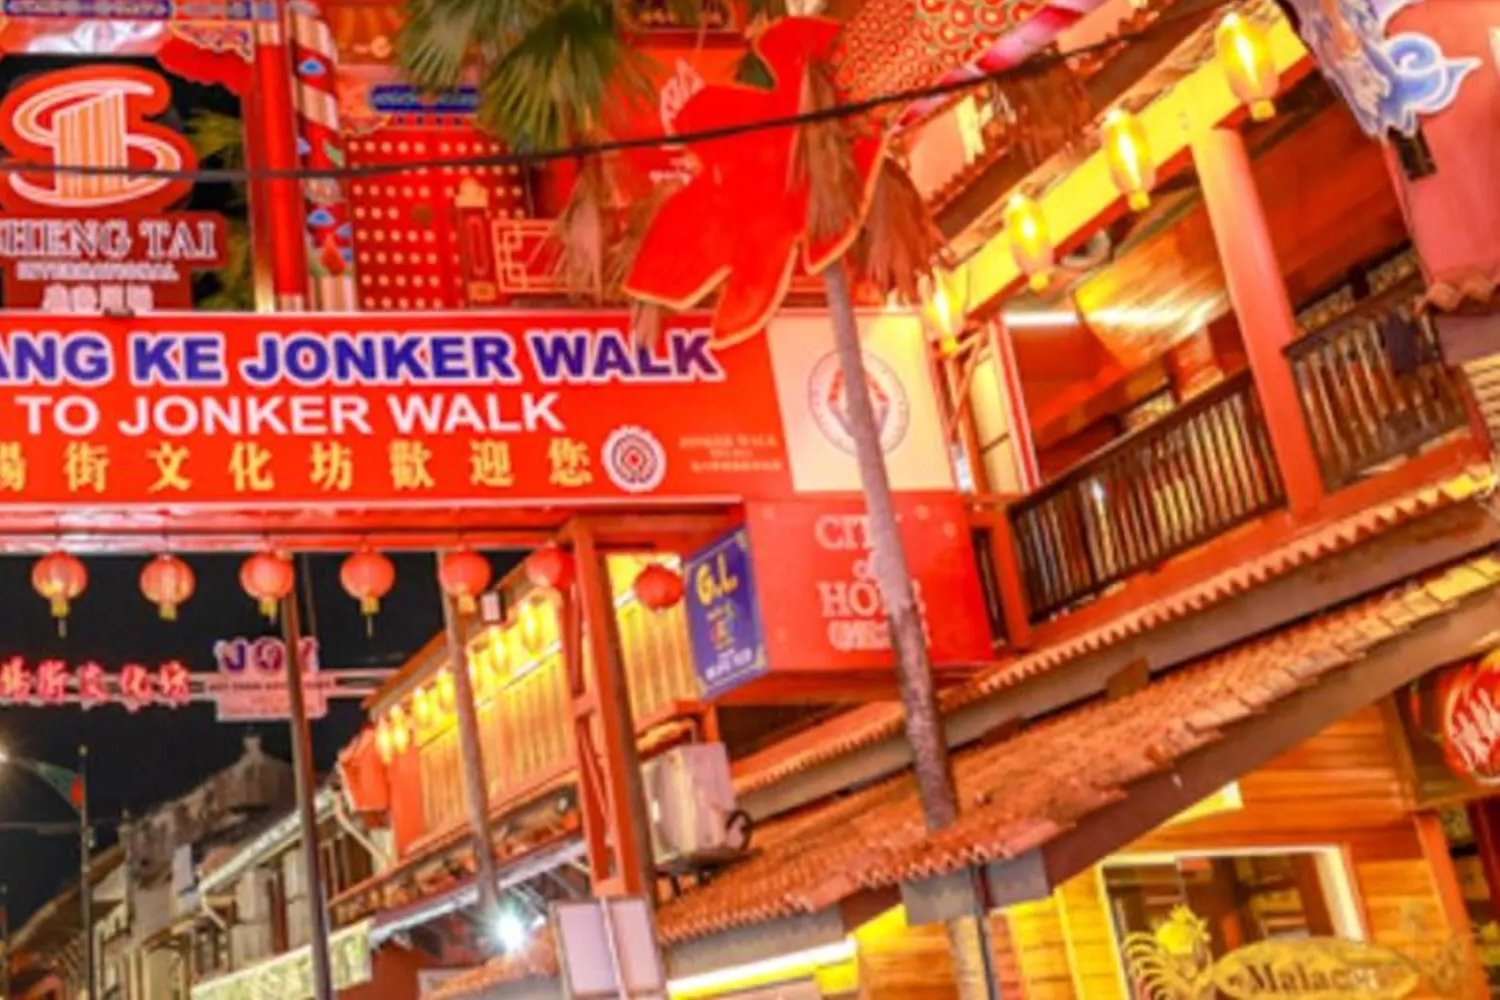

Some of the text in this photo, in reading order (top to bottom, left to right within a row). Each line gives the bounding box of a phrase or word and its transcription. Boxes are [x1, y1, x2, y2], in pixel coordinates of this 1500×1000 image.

[138, 219, 219, 259] TAI
[128, 331, 227, 385] KE
[238, 331, 522, 384] JONKER
[525, 329, 726, 383] WALK
[15, 395, 102, 436] TO
[118, 395, 372, 436] JONKER
[386, 393, 567, 434] WALK
[814, 514, 886, 550] CIT
